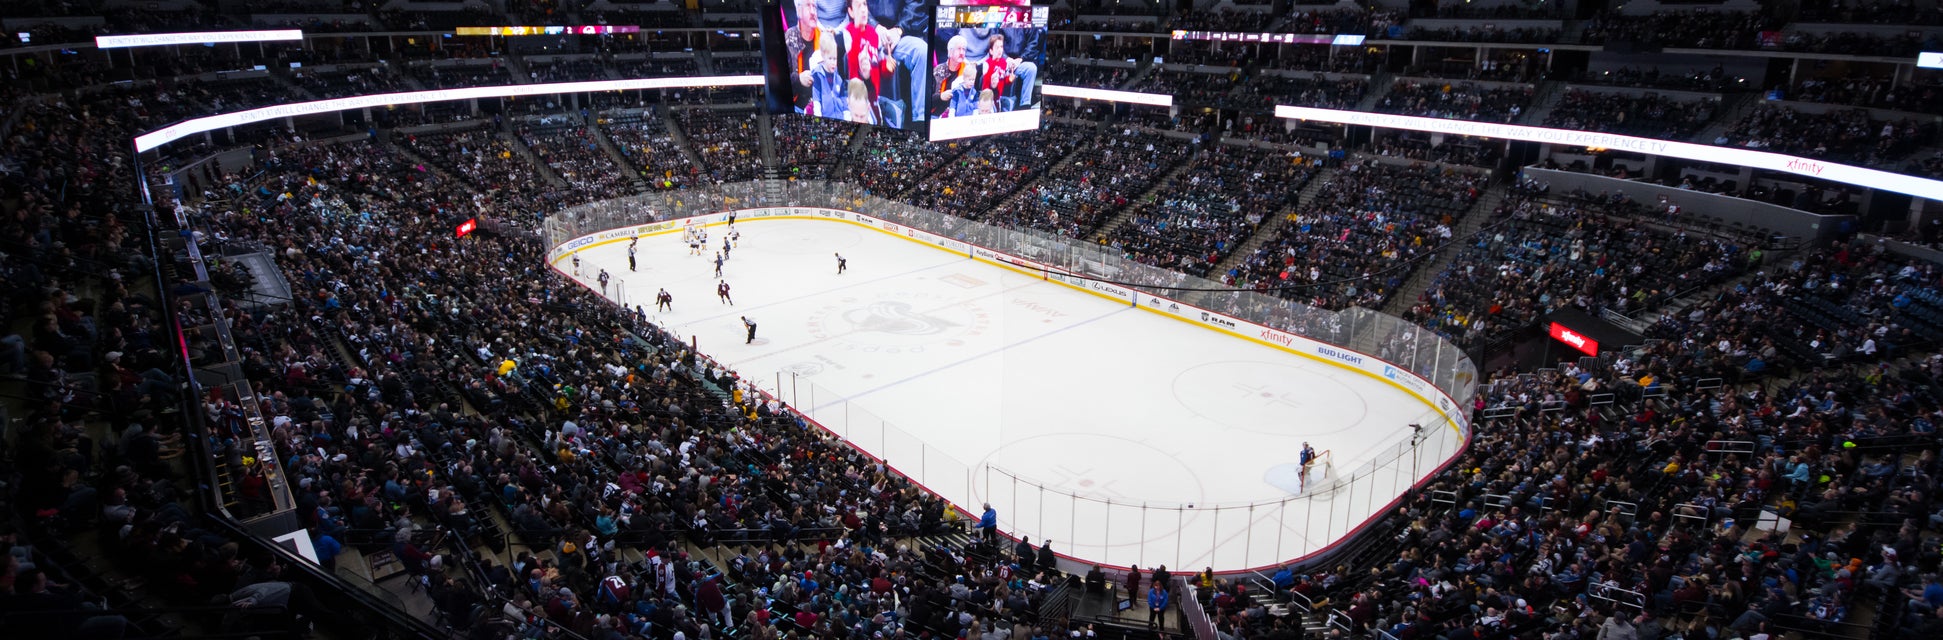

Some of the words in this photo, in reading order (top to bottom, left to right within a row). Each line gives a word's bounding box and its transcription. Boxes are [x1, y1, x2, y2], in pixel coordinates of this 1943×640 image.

[1023, 12, 1029, 23] 2
[296, 102, 329, 113] CHANGE
[384, 92, 435, 103] EXPERIENCE
[1351, 114, 1387, 125] XFINITY
[1404, 118, 1427, 129] WILL
[1431, 120, 1475, 133] CHANGE
[1481, 124, 1501, 136] THE
[1507, 126, 1533, 138] WAY
[1537, 129, 1561, 141] YOU
[1566, 131, 1646, 150] EXPERIENCE
[1650, 141, 1668, 153] TV
[1786, 157, 1825, 176] xfinity
[567, 236, 594, 250] GEICO
[1101, 285, 1127, 297] LEXUS
[1211, 316, 1236, 328] RAM
[1260, 329, 1293, 346] xfinity
[1318, 346, 1336, 357] BUD
[1337, 349, 1363, 365] LIGHT
